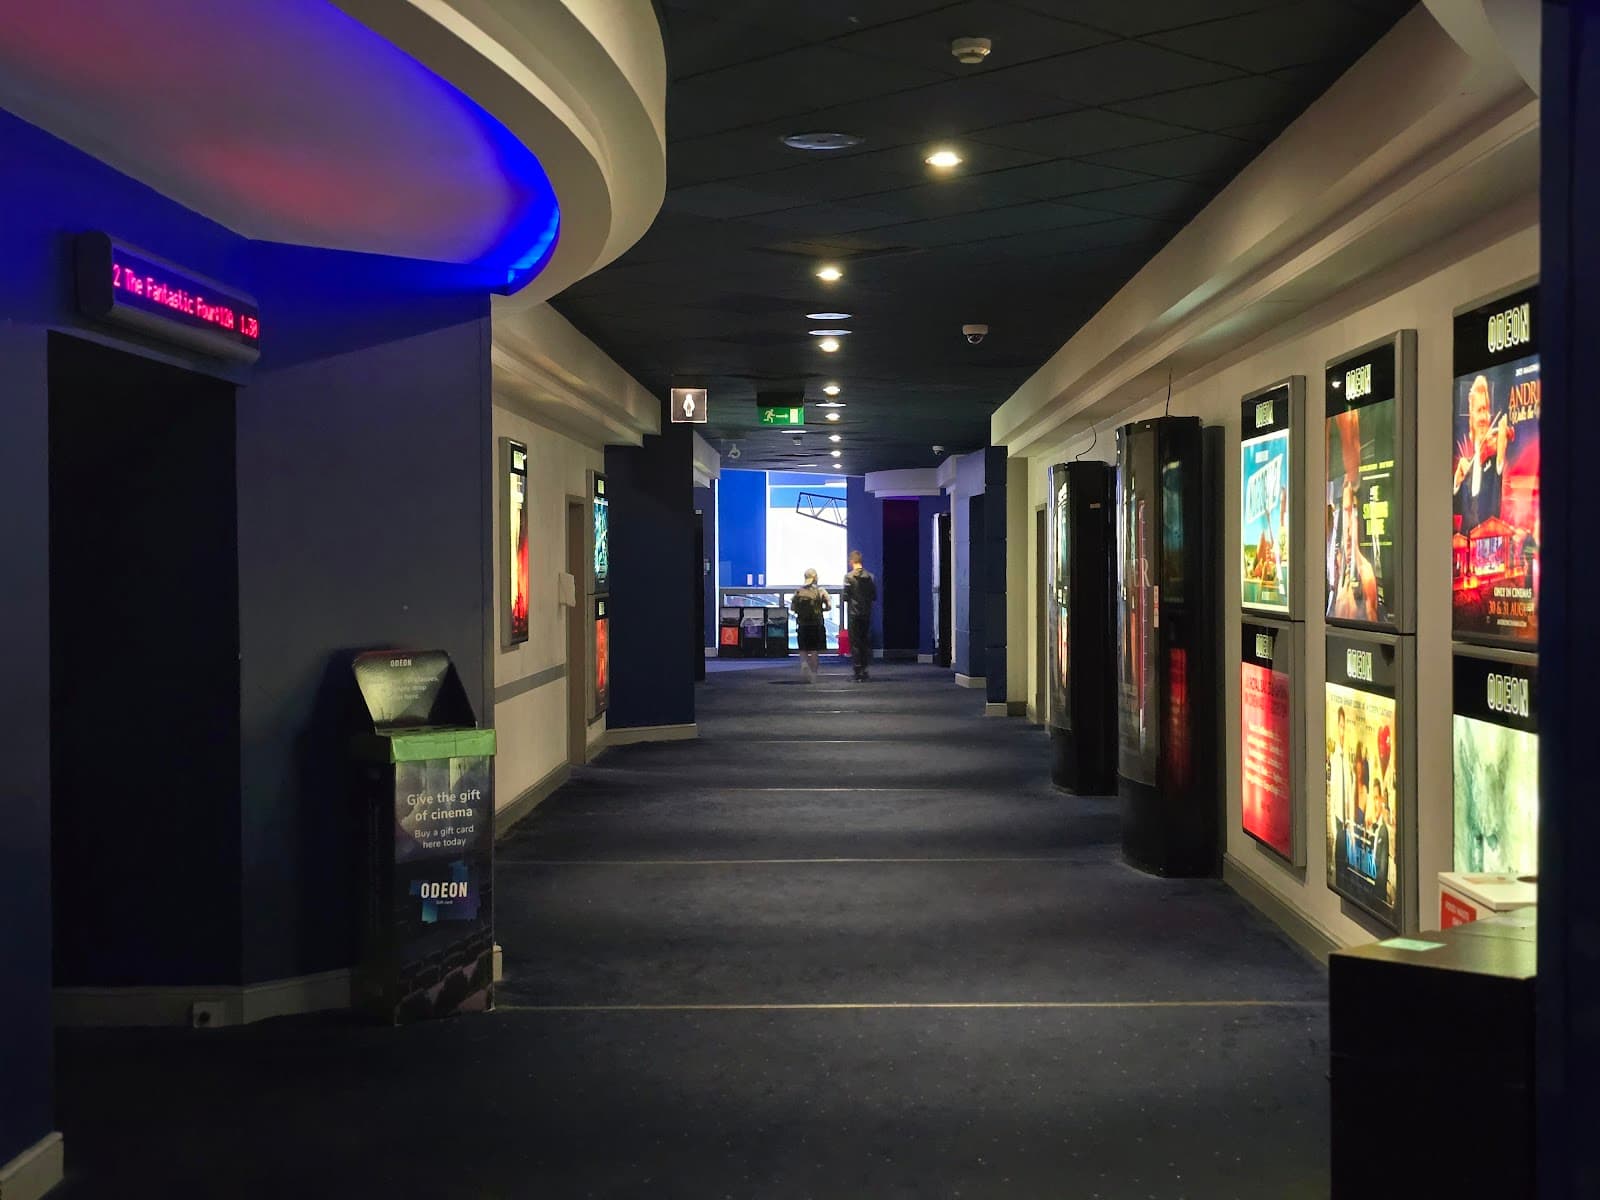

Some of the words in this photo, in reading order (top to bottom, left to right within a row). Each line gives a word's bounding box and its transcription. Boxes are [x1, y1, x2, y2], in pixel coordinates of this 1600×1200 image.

[113, 264, 120, 287] 2
[125, 268, 143, 295] The
[147, 277, 194, 314] Fantastic
[1488, 302, 1530, 353] ODEON
[1346, 363, 1371, 401] ODEON
[1511, 587, 1532, 599] CINEMAS
[1510, 601, 1534, 616] AUG
[390, 659, 412, 667] ODEON
[1347, 648, 1373, 682] ODEON
[1487, 673, 1528, 717] ODEON
[407, 793, 434, 806] Give
[437, 791, 456, 803] the
[459, 789, 481, 803] gift
[415, 809, 428, 822] of
[431, 807, 473, 821] cinema
[414, 829, 431, 840] Buy
[440, 826, 454, 838] gift
[456, 825, 474, 834] card
[422, 840, 442, 849] here
[443, 837, 467, 848] today
[420, 881, 468, 899] ODEON
